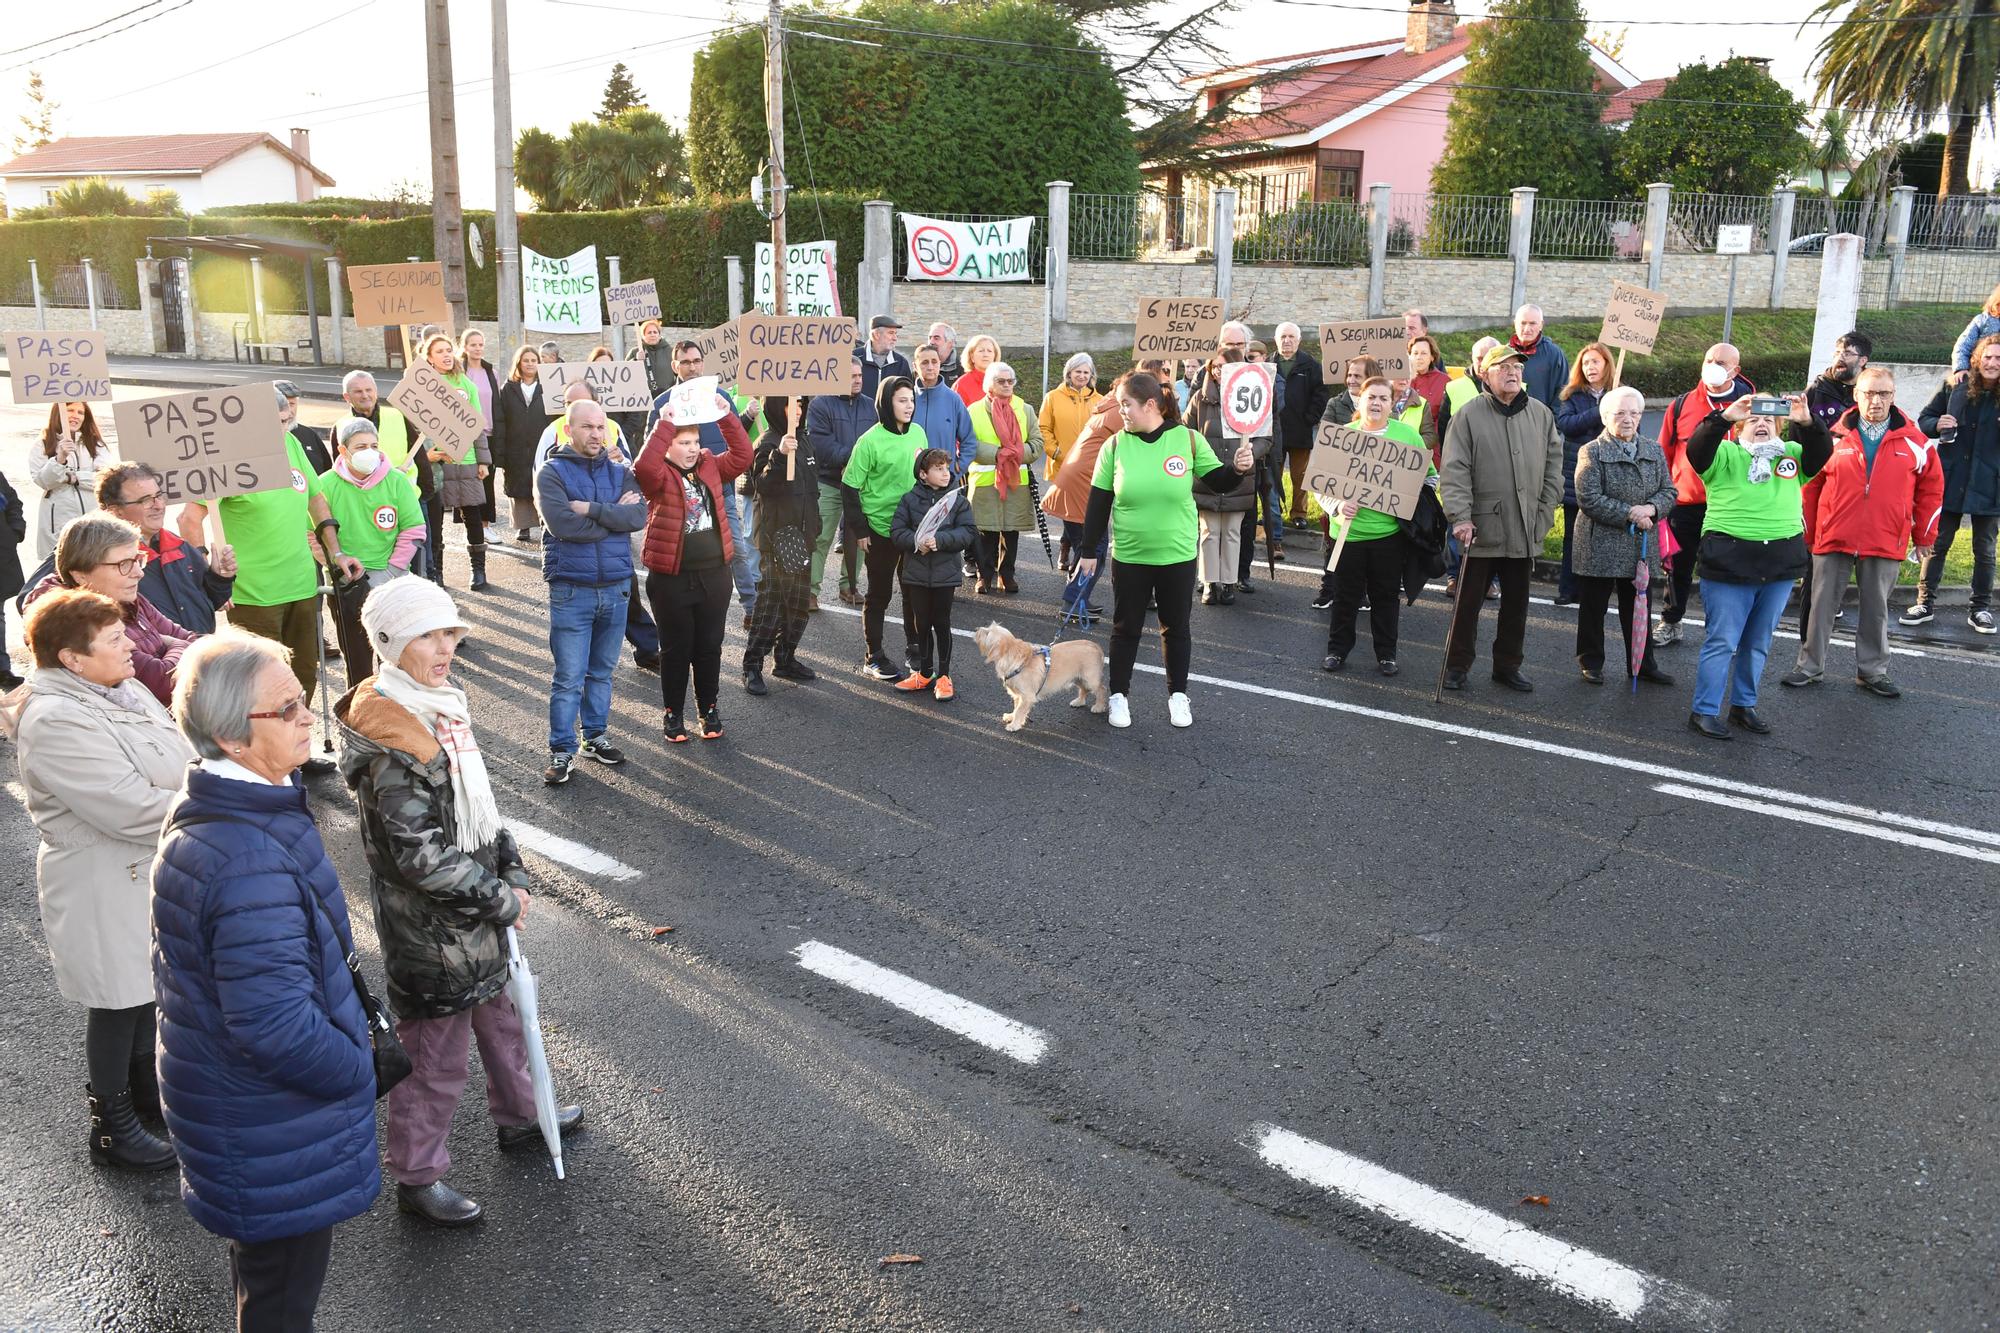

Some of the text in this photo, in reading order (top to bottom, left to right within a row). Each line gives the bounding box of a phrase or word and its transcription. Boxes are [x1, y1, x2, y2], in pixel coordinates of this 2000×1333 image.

[968, 223, 1012, 247] VAI
[761, 248, 770, 265] O
[918, 237, 952, 265] 50
[532, 256, 569, 275] PASO
[960, 248, 1026, 279] A MODO
[360, 271, 442, 289] SEGURIDAD
[525, 275, 594, 295] DE PEÓNS
[607, 283, 655, 302] SEGURIDADE
[1614, 286, 1654, 311] QUEREMOS
[377, 296, 424, 315] VIAL
[625, 299, 643, 307] PARA
[1147, 300, 1219, 320] 6 MESES
[612, 306, 659, 324] O COUTO
[1634, 309, 1660, 325] CRUZAR
[723, 325, 739, 344] AN
[750, 323, 853, 347] QUEREMOS
[1166, 321, 1196, 333] SEN
[1325, 327, 1406, 344] A SEGURIDADE
[1613, 324, 1654, 348] SEGURIDAD
[17, 337, 93, 359] PASO
[720, 345, 739, 363] SIN
[48, 362, 71, 376] DE
[549, 367, 566, 386] 1
[584, 366, 631, 384] ANO
[746, 358, 839, 382] CRUZAR
[1329, 361, 1339, 375] O
[24, 373, 109, 397] PEÓNS
[596, 385, 613, 393] EN
[415, 368, 477, 428] GOBERNO
[1236, 385, 1262, 413] 50
[139, 395, 244, 438] PASO
[400, 388, 461, 451] ESCOITA
[174, 431, 220, 461] DE
[1319, 425, 1423, 471] SEGURIDAD
[1168, 461, 1184, 471] 50
[1347, 457, 1393, 489] PARA
[1777, 461, 1795, 473] 50
[1311, 474, 1400, 516] CRUZAR
[378, 513, 394, 523] 50
